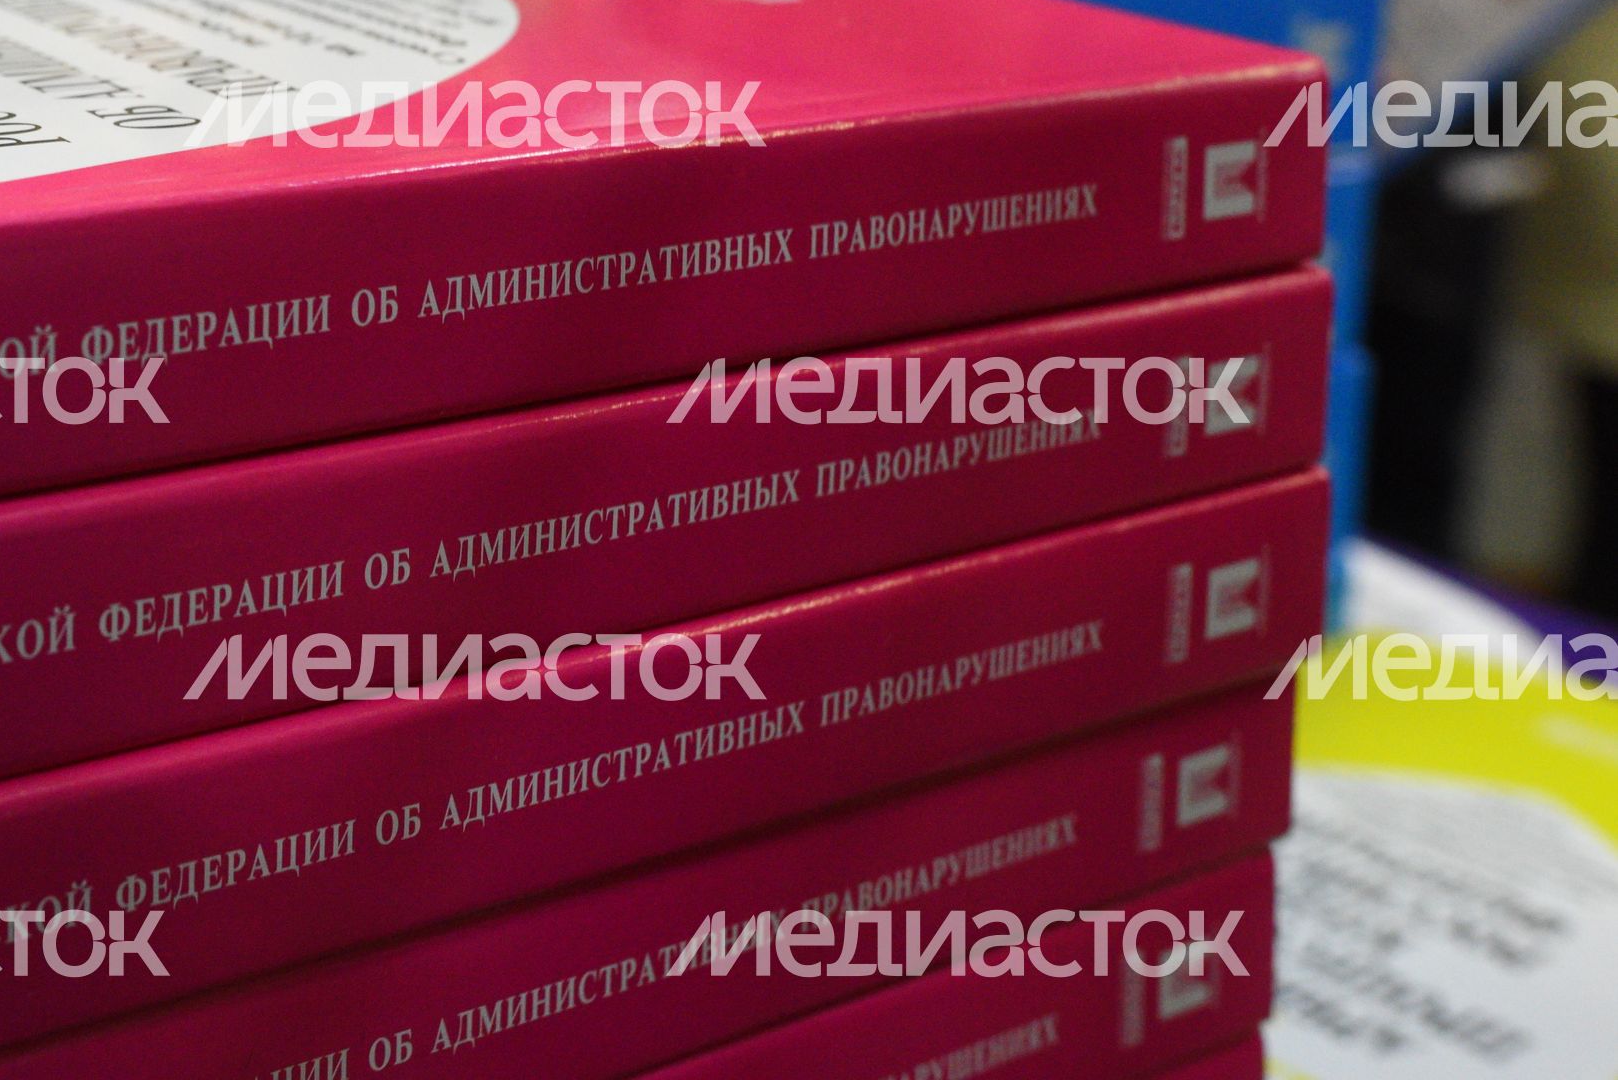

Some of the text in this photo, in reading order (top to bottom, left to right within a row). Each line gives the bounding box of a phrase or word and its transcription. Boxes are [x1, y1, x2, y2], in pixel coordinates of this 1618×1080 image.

[86, 104, 202, 131] ОБ
[81, 294, 331, 366] ФЕДЕРАЦИИ
[350, 285, 399, 327] ОБ
[417, 227, 794, 323] АДМИНИСТРАТИВНЫХ
[809, 183, 1099, 261] ПРАВОНАРУШЕНИЯХ
[98, 560, 346, 643] ФЕДЕРАЦИИ
[364, 547, 412, 591] ОБ
[430, 469, 801, 584] АДМИНИСТРАТИВНЫХ
[814, 406, 1102, 498] ПРАВОНАРУШЕНИЯХ
[115, 819, 358, 913] ФЕДЕРАЦИИ
[376, 801, 423, 847] ОБ
[439, 700, 807, 830] АДМИНИСТРАТИВНЫХ
[820, 619, 1104, 728] ПРАВОНАРУШЕНИЯХ
[368, 813, 1079, 1072] ОБ АДМИНИСТРАТИВНЫХ ПРАВОНАРУШЕНИЯХ
